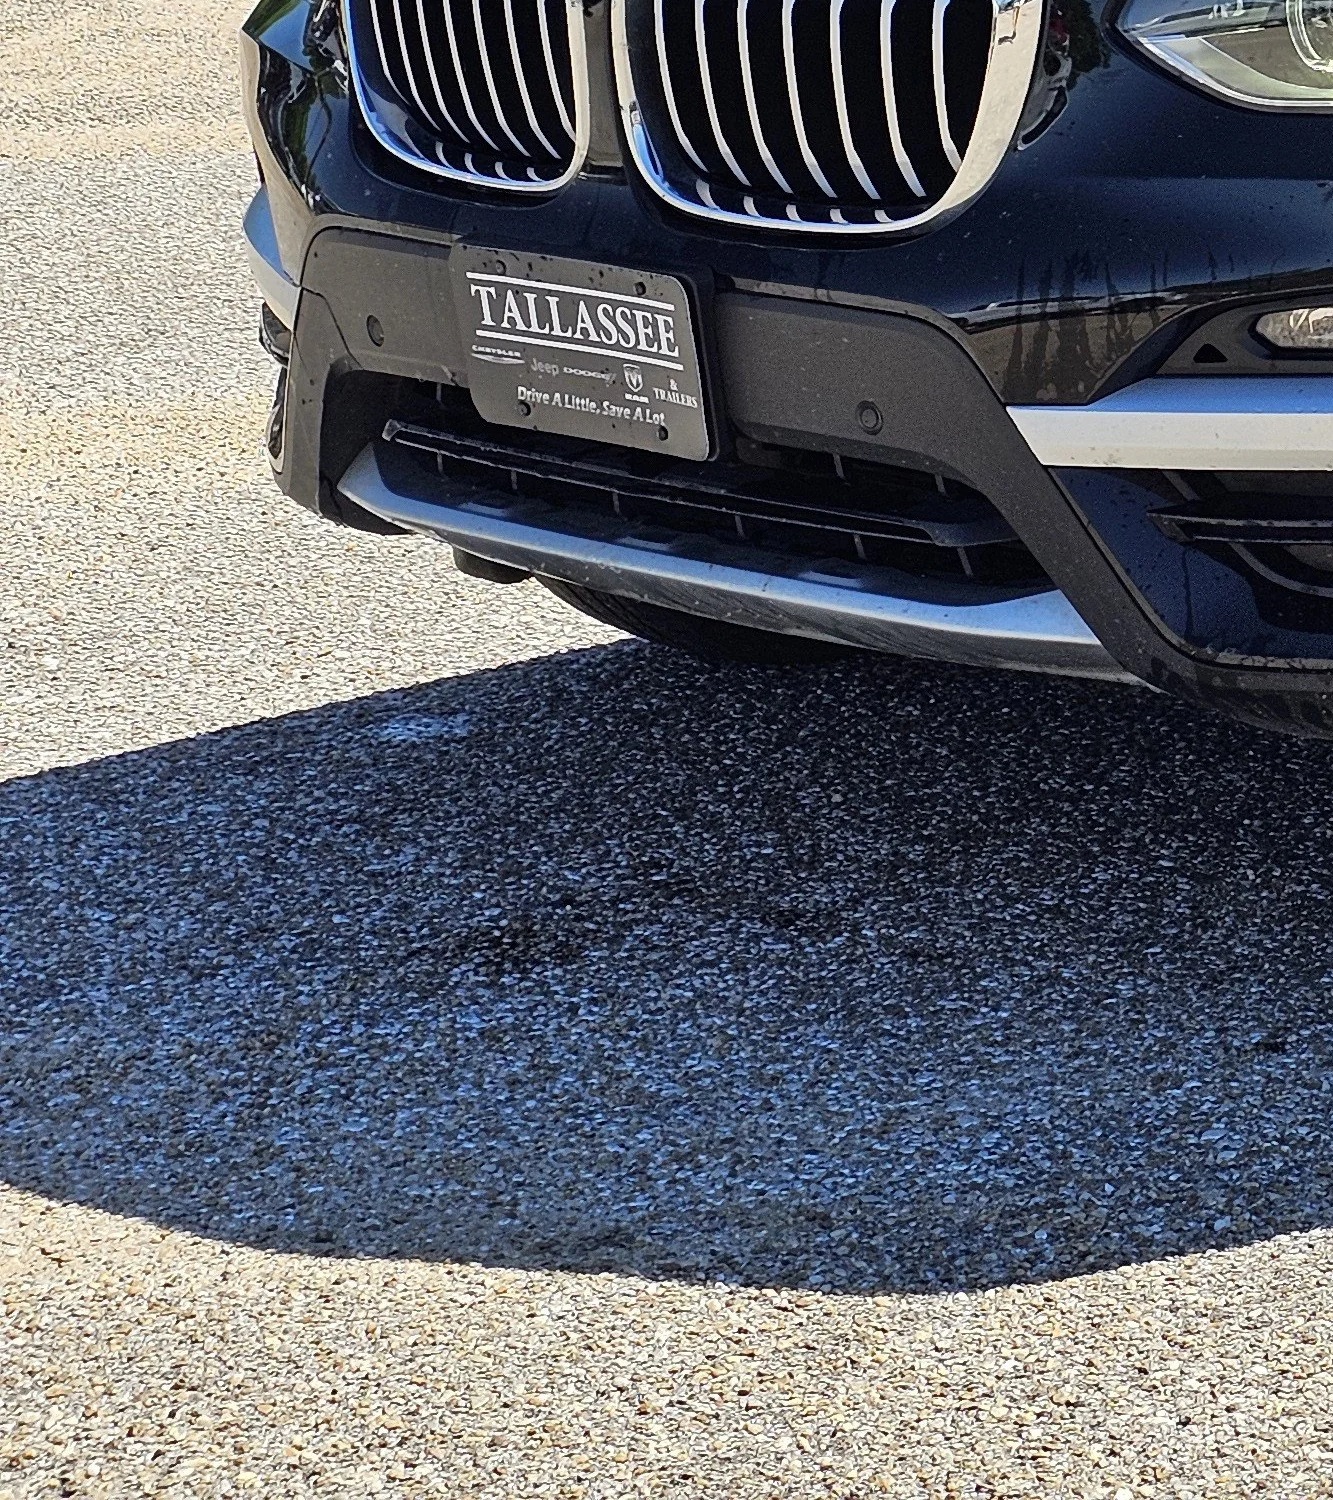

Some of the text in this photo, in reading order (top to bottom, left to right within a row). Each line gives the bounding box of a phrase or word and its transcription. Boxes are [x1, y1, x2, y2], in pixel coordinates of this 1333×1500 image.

[470, 283, 679, 358] TALLASSEE
[530, 357, 560, 378] Jeep
[517, 385, 666, 427] Drive A Little, Save A Lot
[652, 387, 698, 409] TRAILERS
